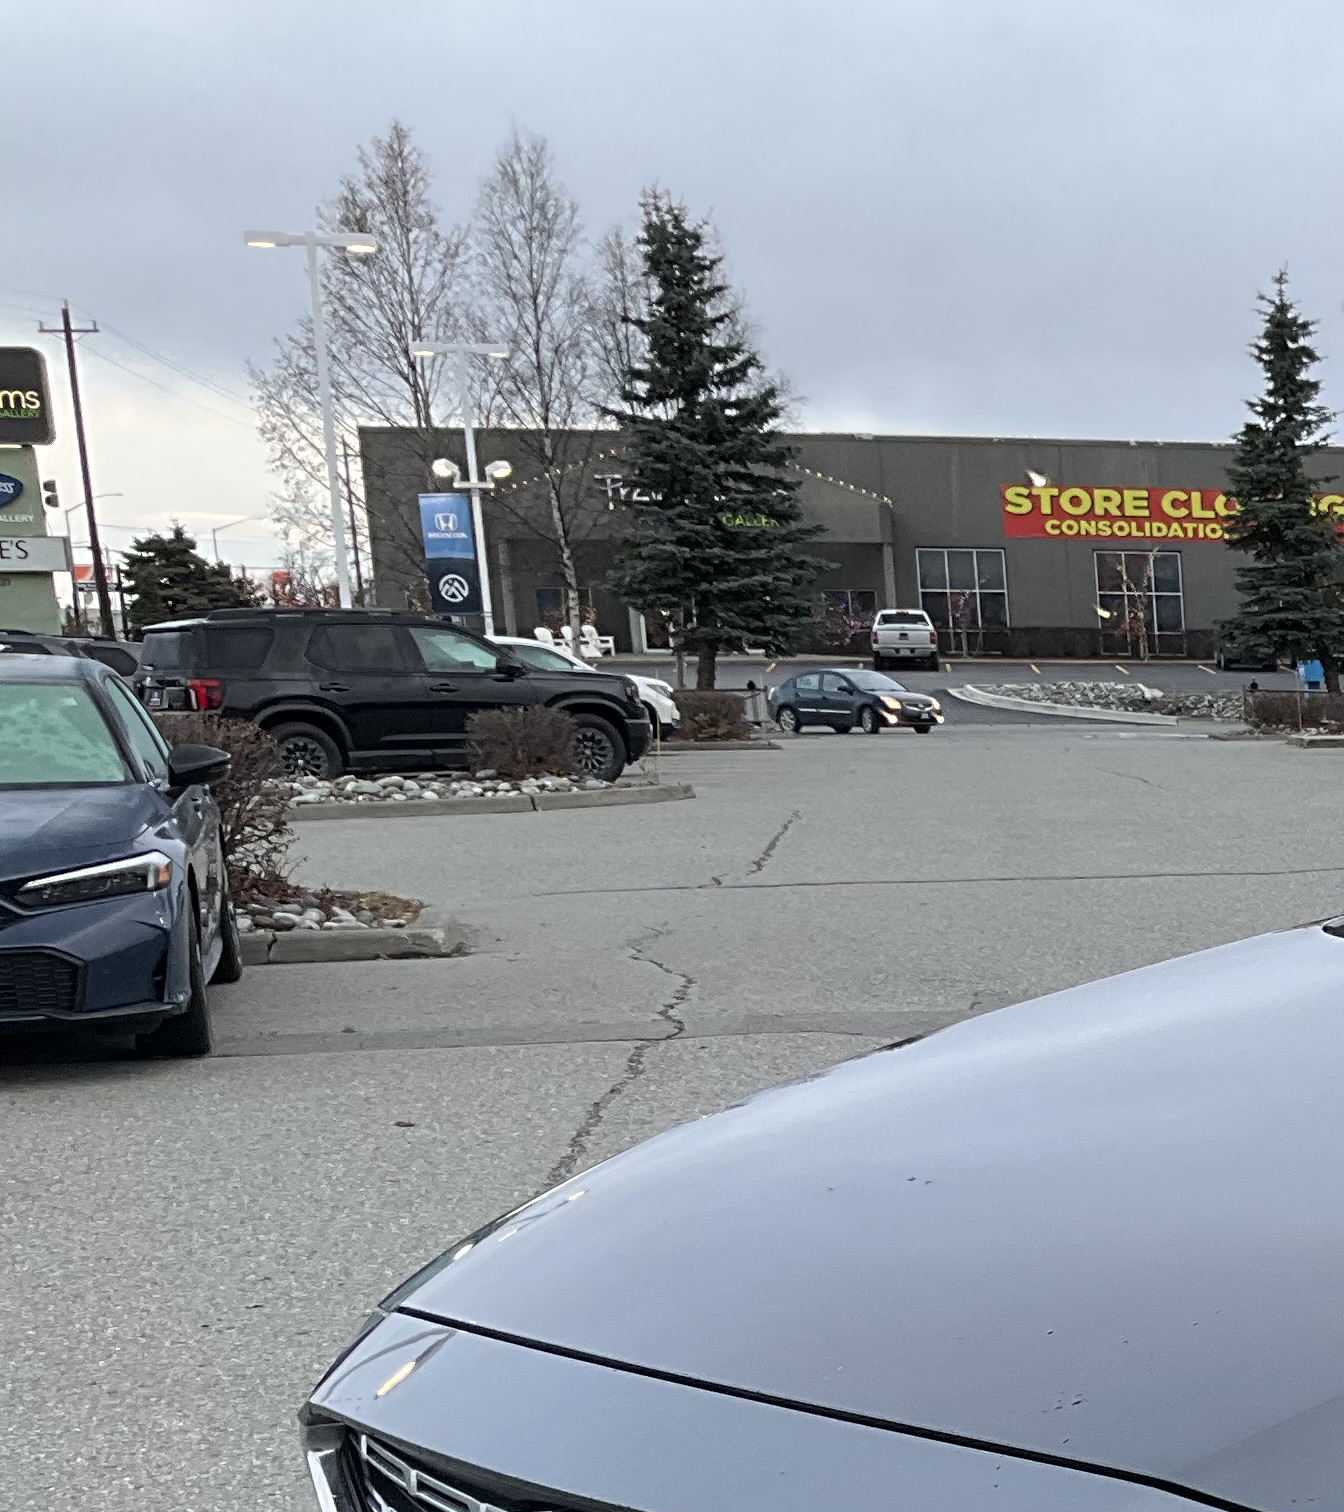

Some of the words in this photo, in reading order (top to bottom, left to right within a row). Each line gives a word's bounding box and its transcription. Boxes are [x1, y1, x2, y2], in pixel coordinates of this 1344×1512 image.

[1005, 486, 1150, 518] STORE
[428, 531, 468, 539] HONDA
[1045, 519, 1240, 539] CONSOLIDATIO
